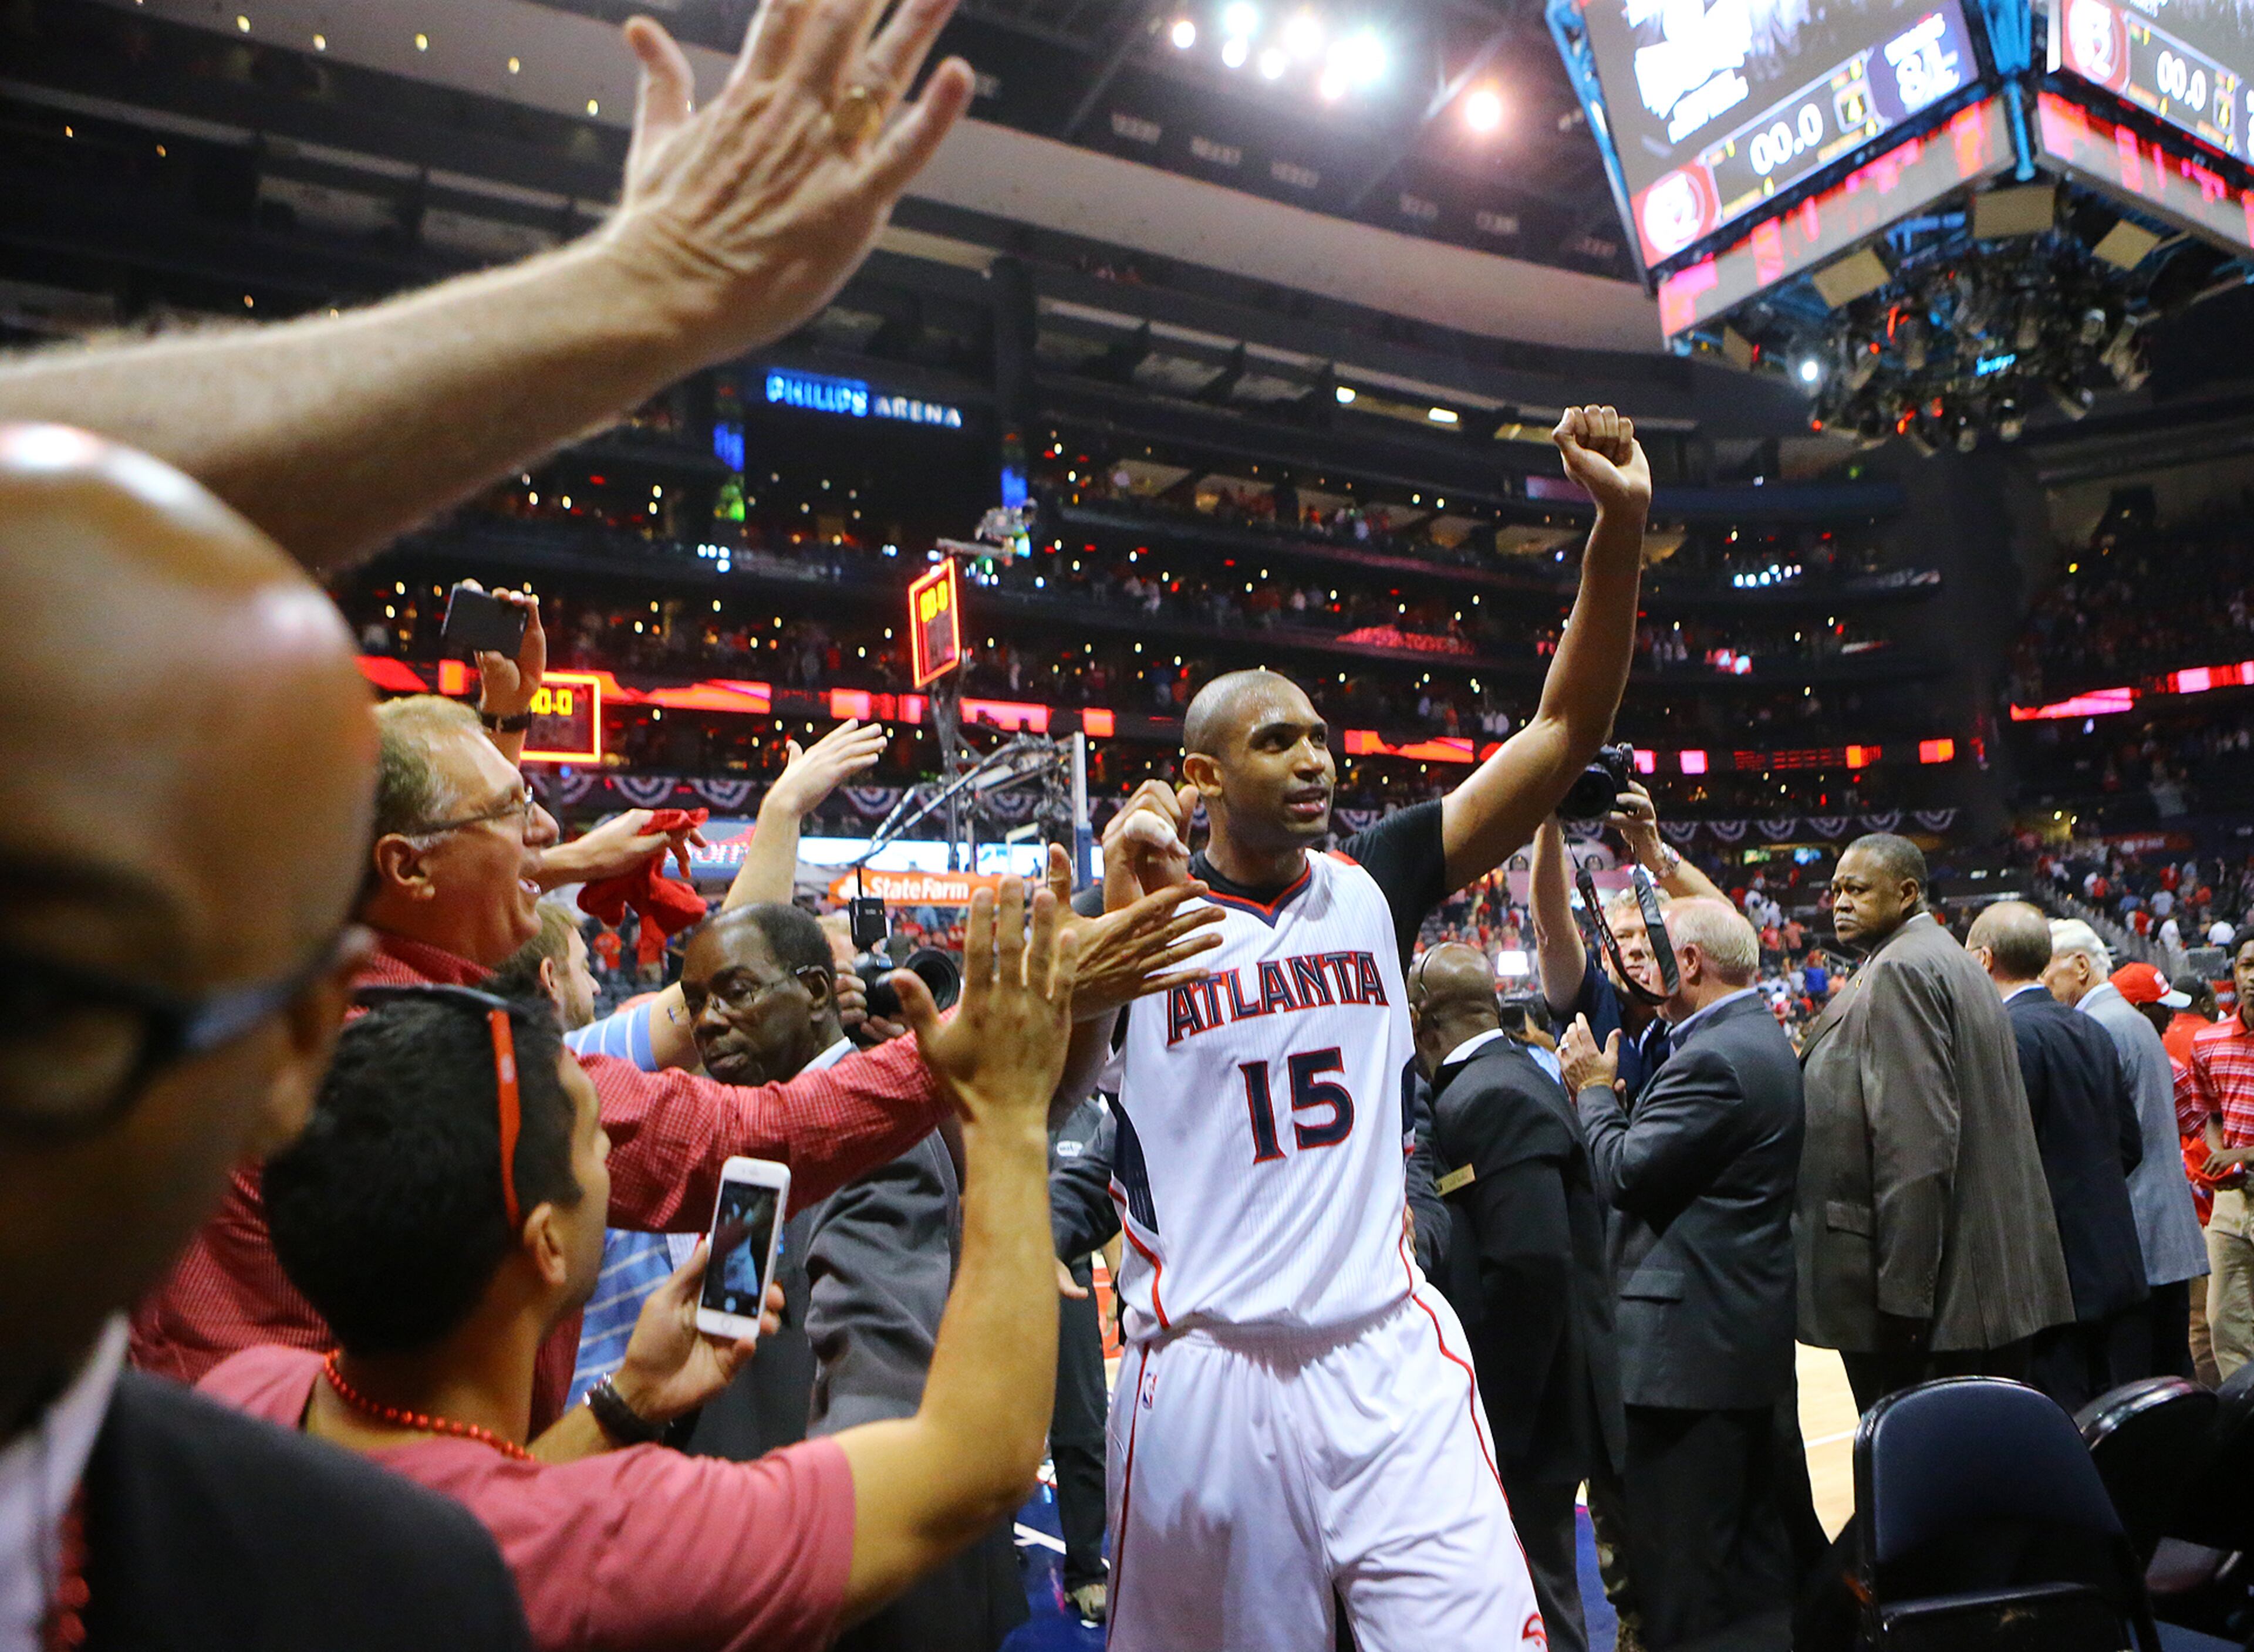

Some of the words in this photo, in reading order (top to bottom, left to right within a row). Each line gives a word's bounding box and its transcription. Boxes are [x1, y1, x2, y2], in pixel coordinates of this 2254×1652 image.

[2157, 50, 2206, 111] 00.0
[1750, 103, 1823, 175] 00.0
[873, 395, 962, 428] ARENA
[1167, 951, 1390, 1046] ATLANTA
[1238, 1046, 1355, 1165] 15
